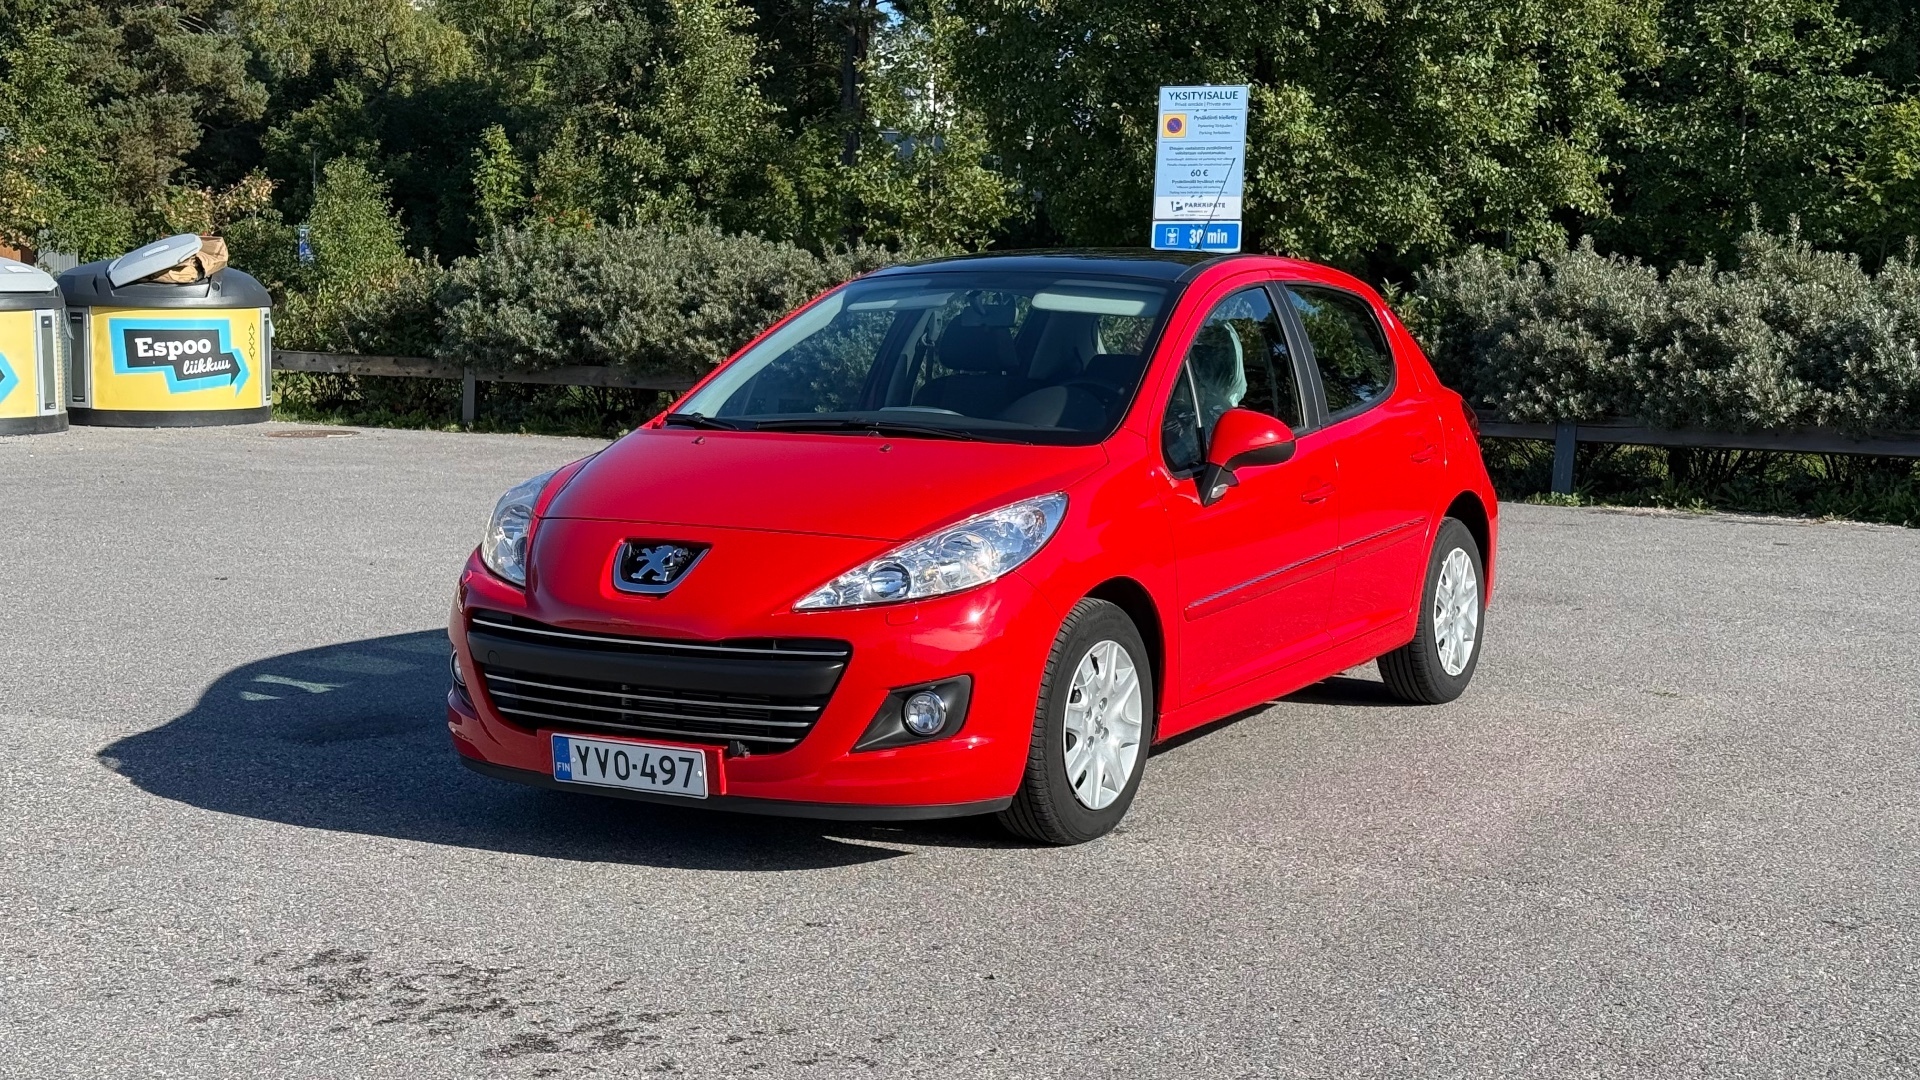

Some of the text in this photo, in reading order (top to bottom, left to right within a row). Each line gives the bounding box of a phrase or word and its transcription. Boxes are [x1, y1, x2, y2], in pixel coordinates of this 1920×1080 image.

[1168, 90, 1239, 100] YKSITYISALUE
[1190, 169, 1209, 177] 60 €
[1189, 229, 1228, 244] 30 min
[134, 337, 211, 360] Espoo
[183, 357, 231, 375] liikkuu
[557, 761, 571, 773] FIN
[575, 744, 695, 788] YVO-497
